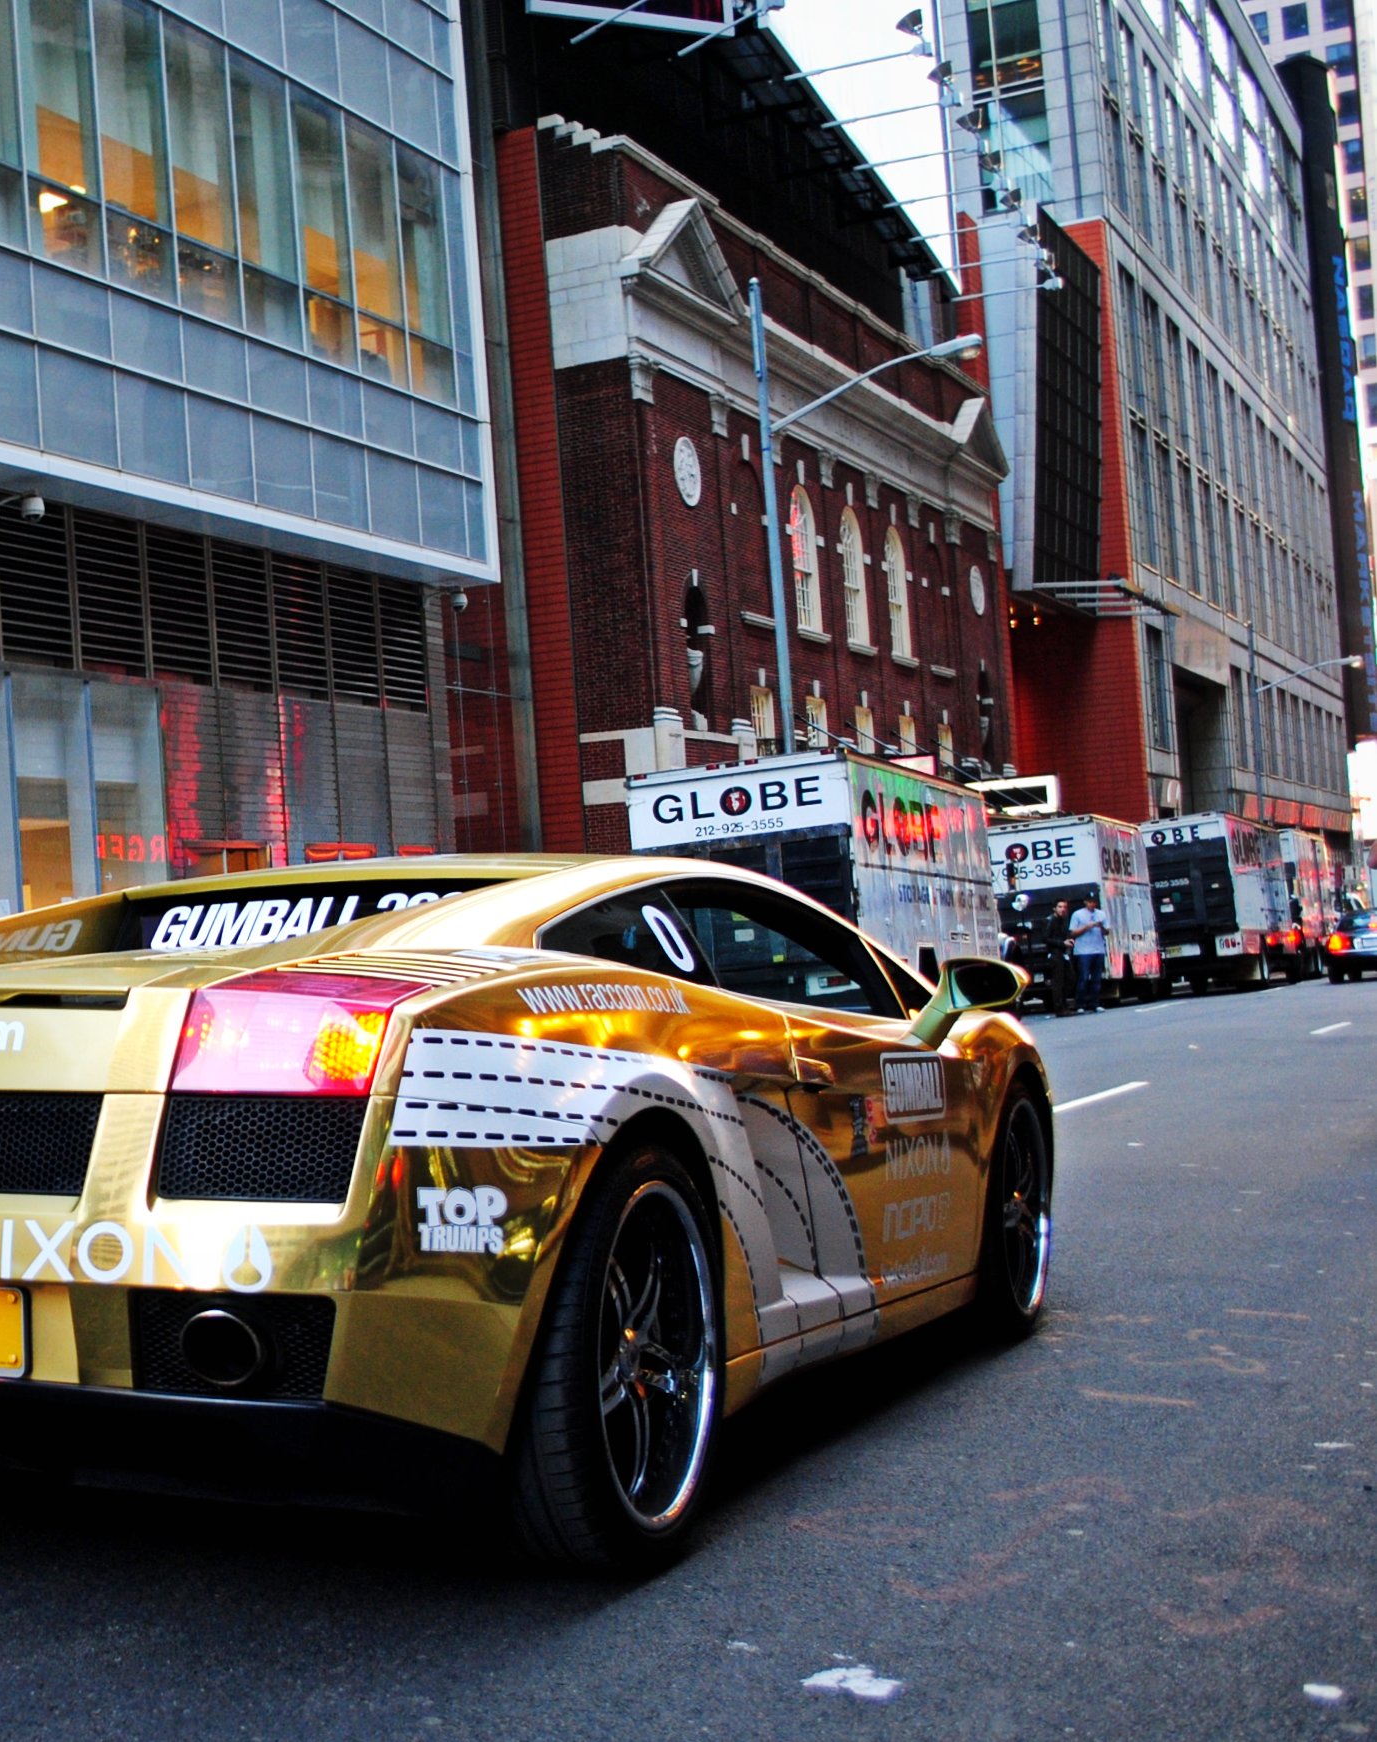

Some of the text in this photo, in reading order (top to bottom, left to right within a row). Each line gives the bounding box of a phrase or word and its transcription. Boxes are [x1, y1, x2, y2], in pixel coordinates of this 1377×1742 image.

[1332, 255, 1355, 422] NASDAQ
[652, 775, 823, 825] GLOBE
[694, 817, 784, 837] 212-925-3555
[1151, 825, 1200, 845] OBE
[988, 837, 1076, 866] LOBE
[150, 895, 360, 950] GUMBALL
[516, 980, 691, 1015] www.raccoon.co.uk
[417, 1185, 507, 1227] TOP
[418, 1223, 504, 1254] TRUMPS
